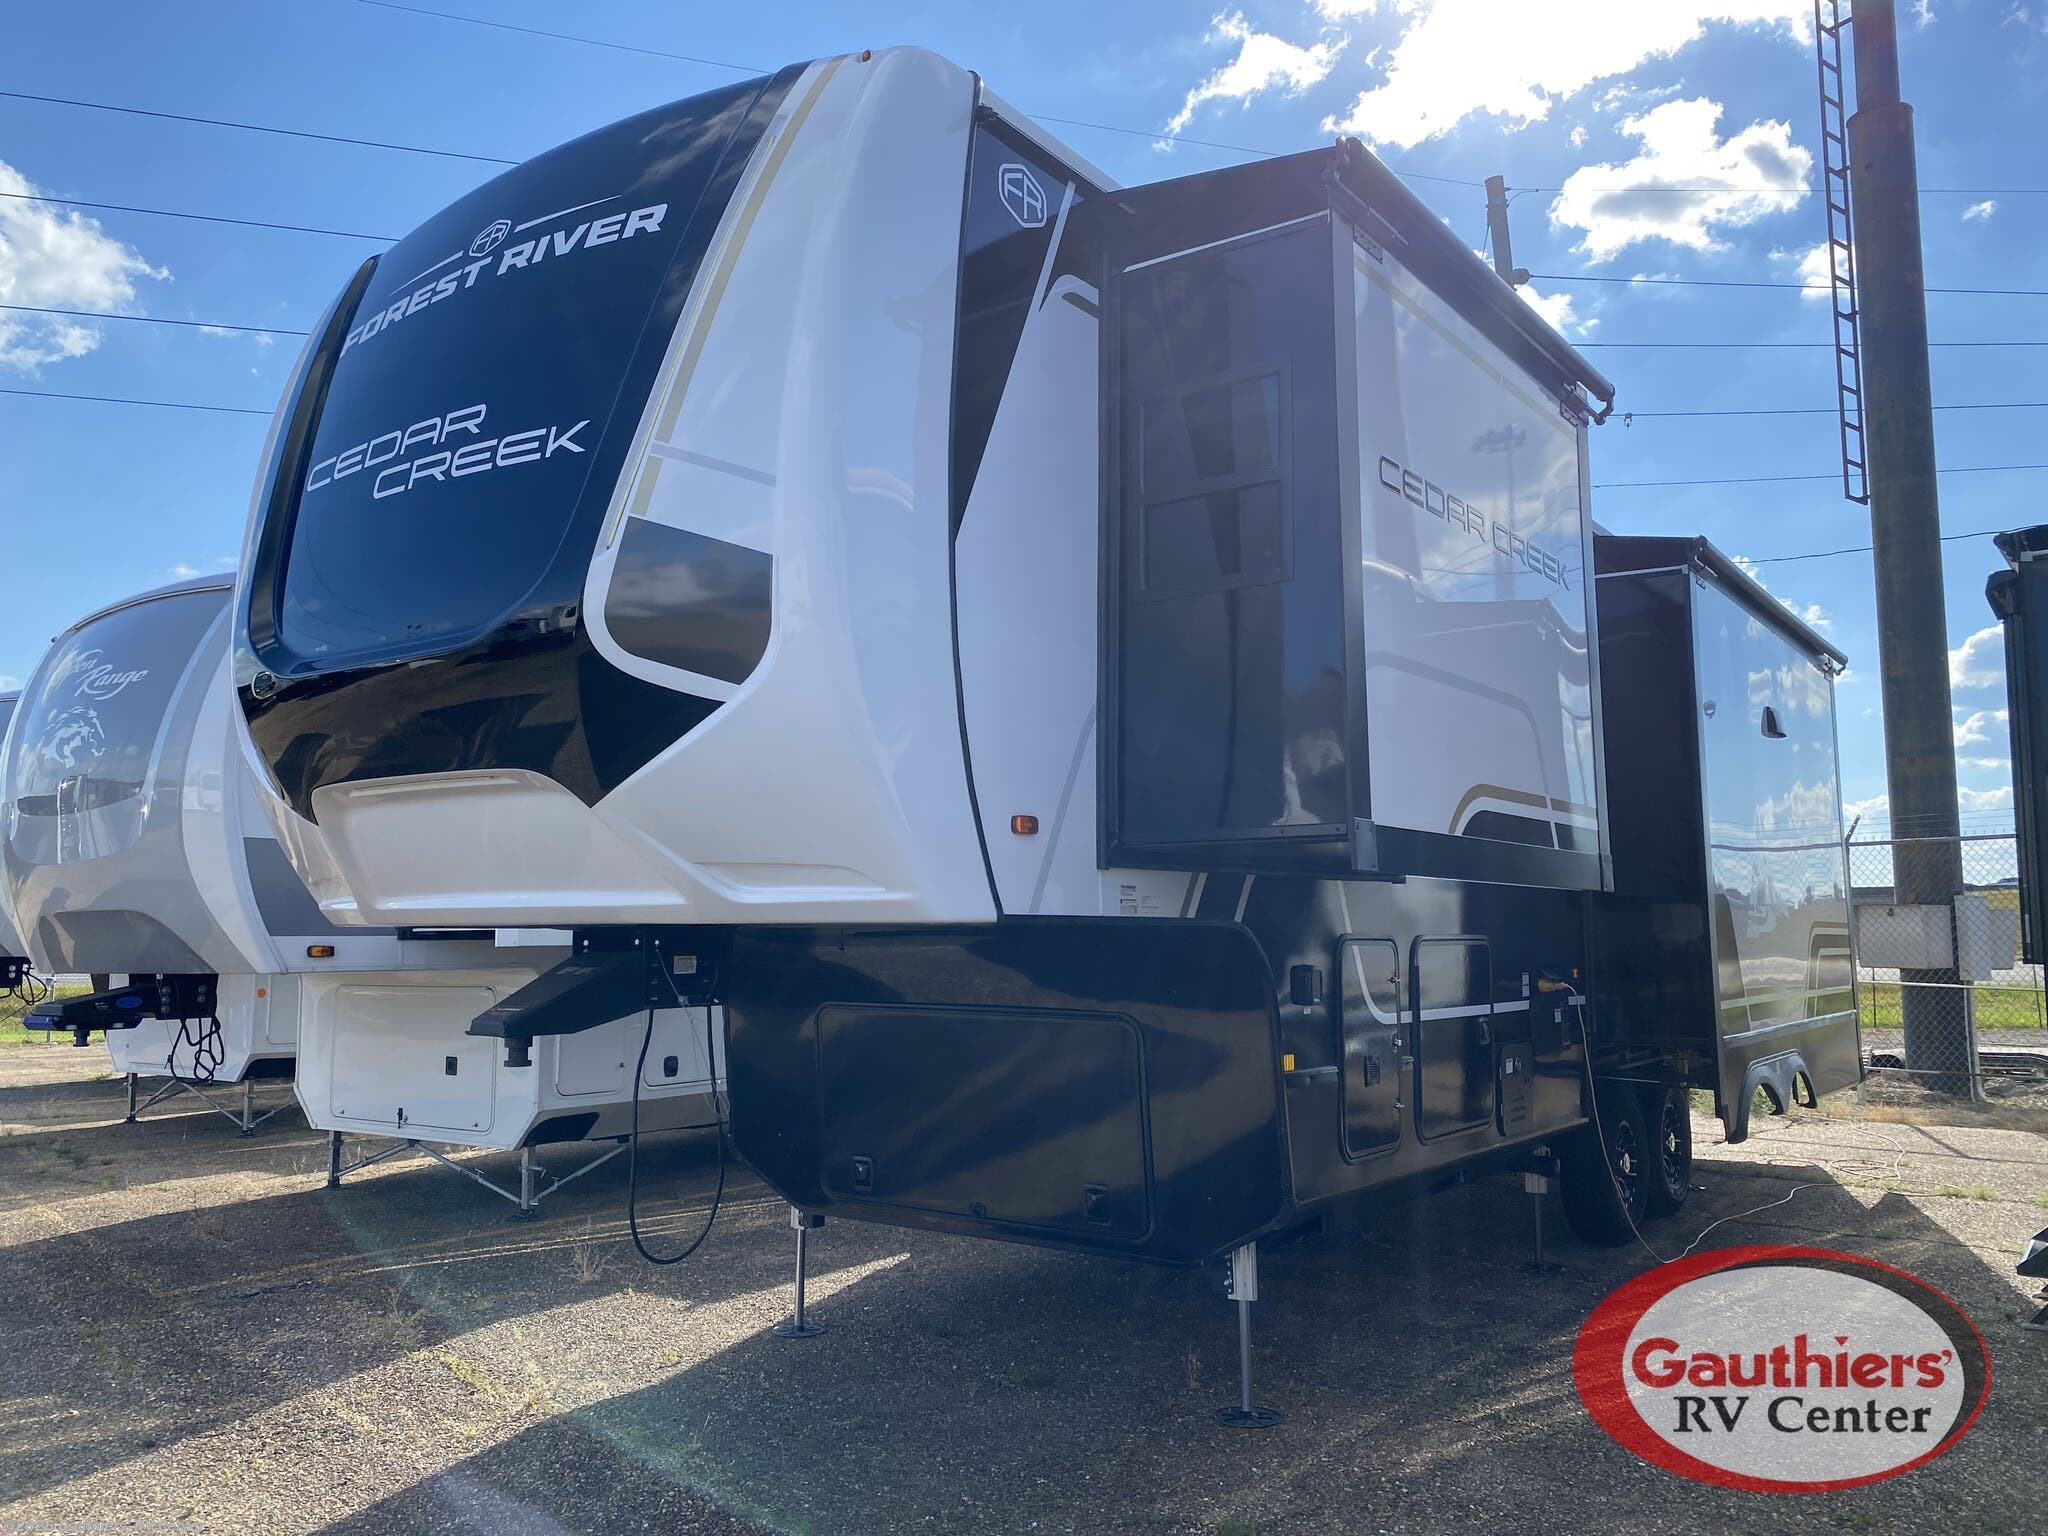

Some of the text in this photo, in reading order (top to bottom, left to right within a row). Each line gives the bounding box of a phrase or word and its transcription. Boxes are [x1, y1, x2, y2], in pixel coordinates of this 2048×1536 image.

[339, 203, 669, 358] FOREST RIVER
[306, 403, 487, 493] CEDAR
[373, 420, 591, 500] CREEK
[1379, 455, 1570, 591] CEDAR CREEK
[74, 663, 149, 700] Range
